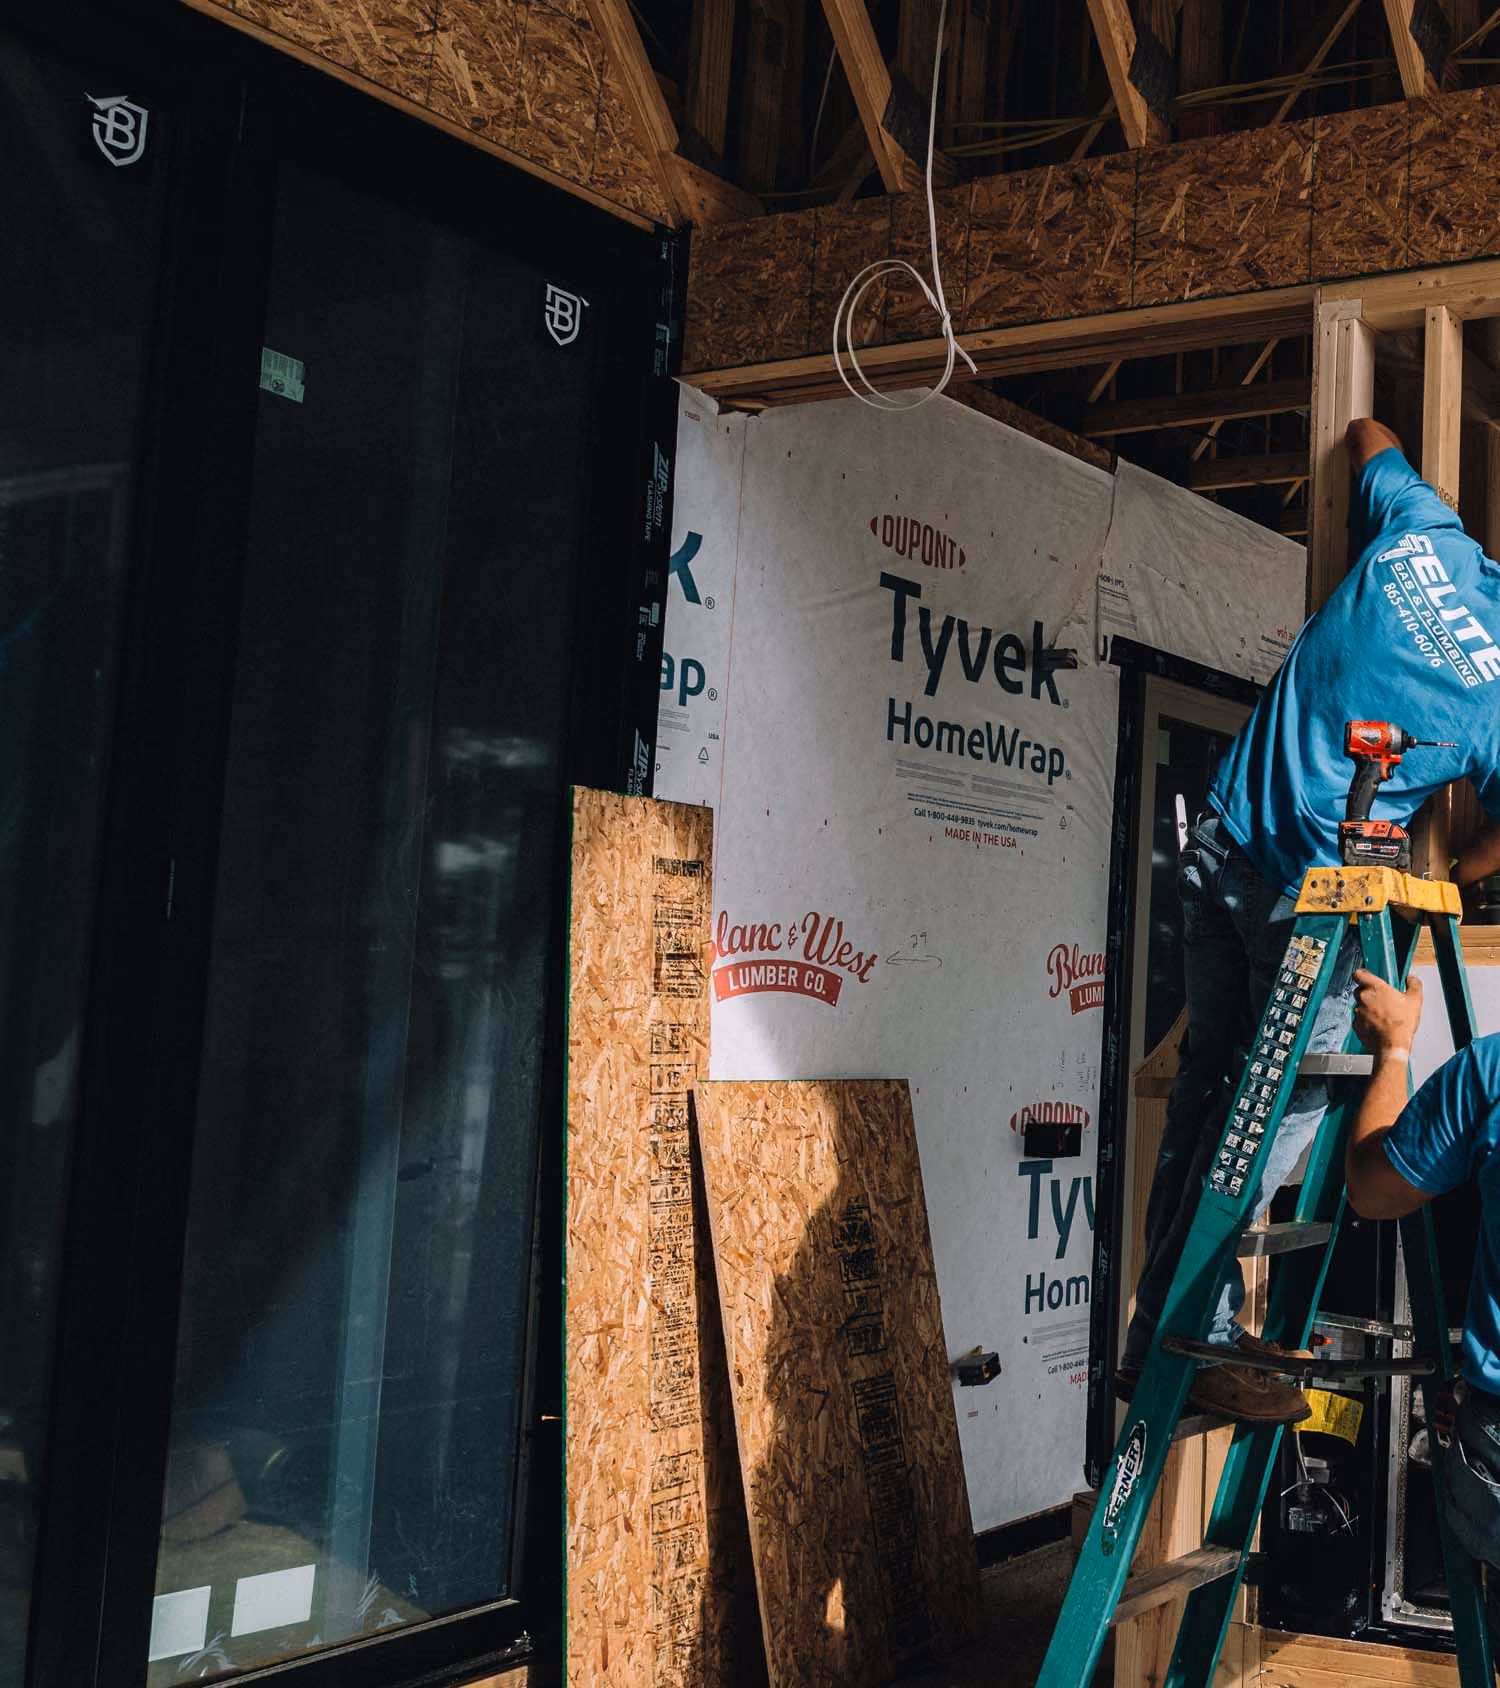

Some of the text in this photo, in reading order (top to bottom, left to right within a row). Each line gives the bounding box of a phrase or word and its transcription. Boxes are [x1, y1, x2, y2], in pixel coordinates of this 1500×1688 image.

[882, 514, 957, 570] DUPONT
[880, 571, 1062, 706] Tyvek
[1383, 582, 1445, 668] 865-410-6076
[1394, 562, 1480, 687] GAS & PLUMBING
[887, 698, 1065, 785] HomeWrap
[913, 807, 1039, 838] Call 1-800-448-9835 tyvek.com/homewrap
[944, 827, 1018, 849] MADE IN THE USA
[713, 910, 783, 964] lanc
[787, 922, 798, 950] &
[801, 911, 879, 984] West
[728, 965, 826, 996] LUMBER CO.
[1078, 985, 1104, 1007] LUM
